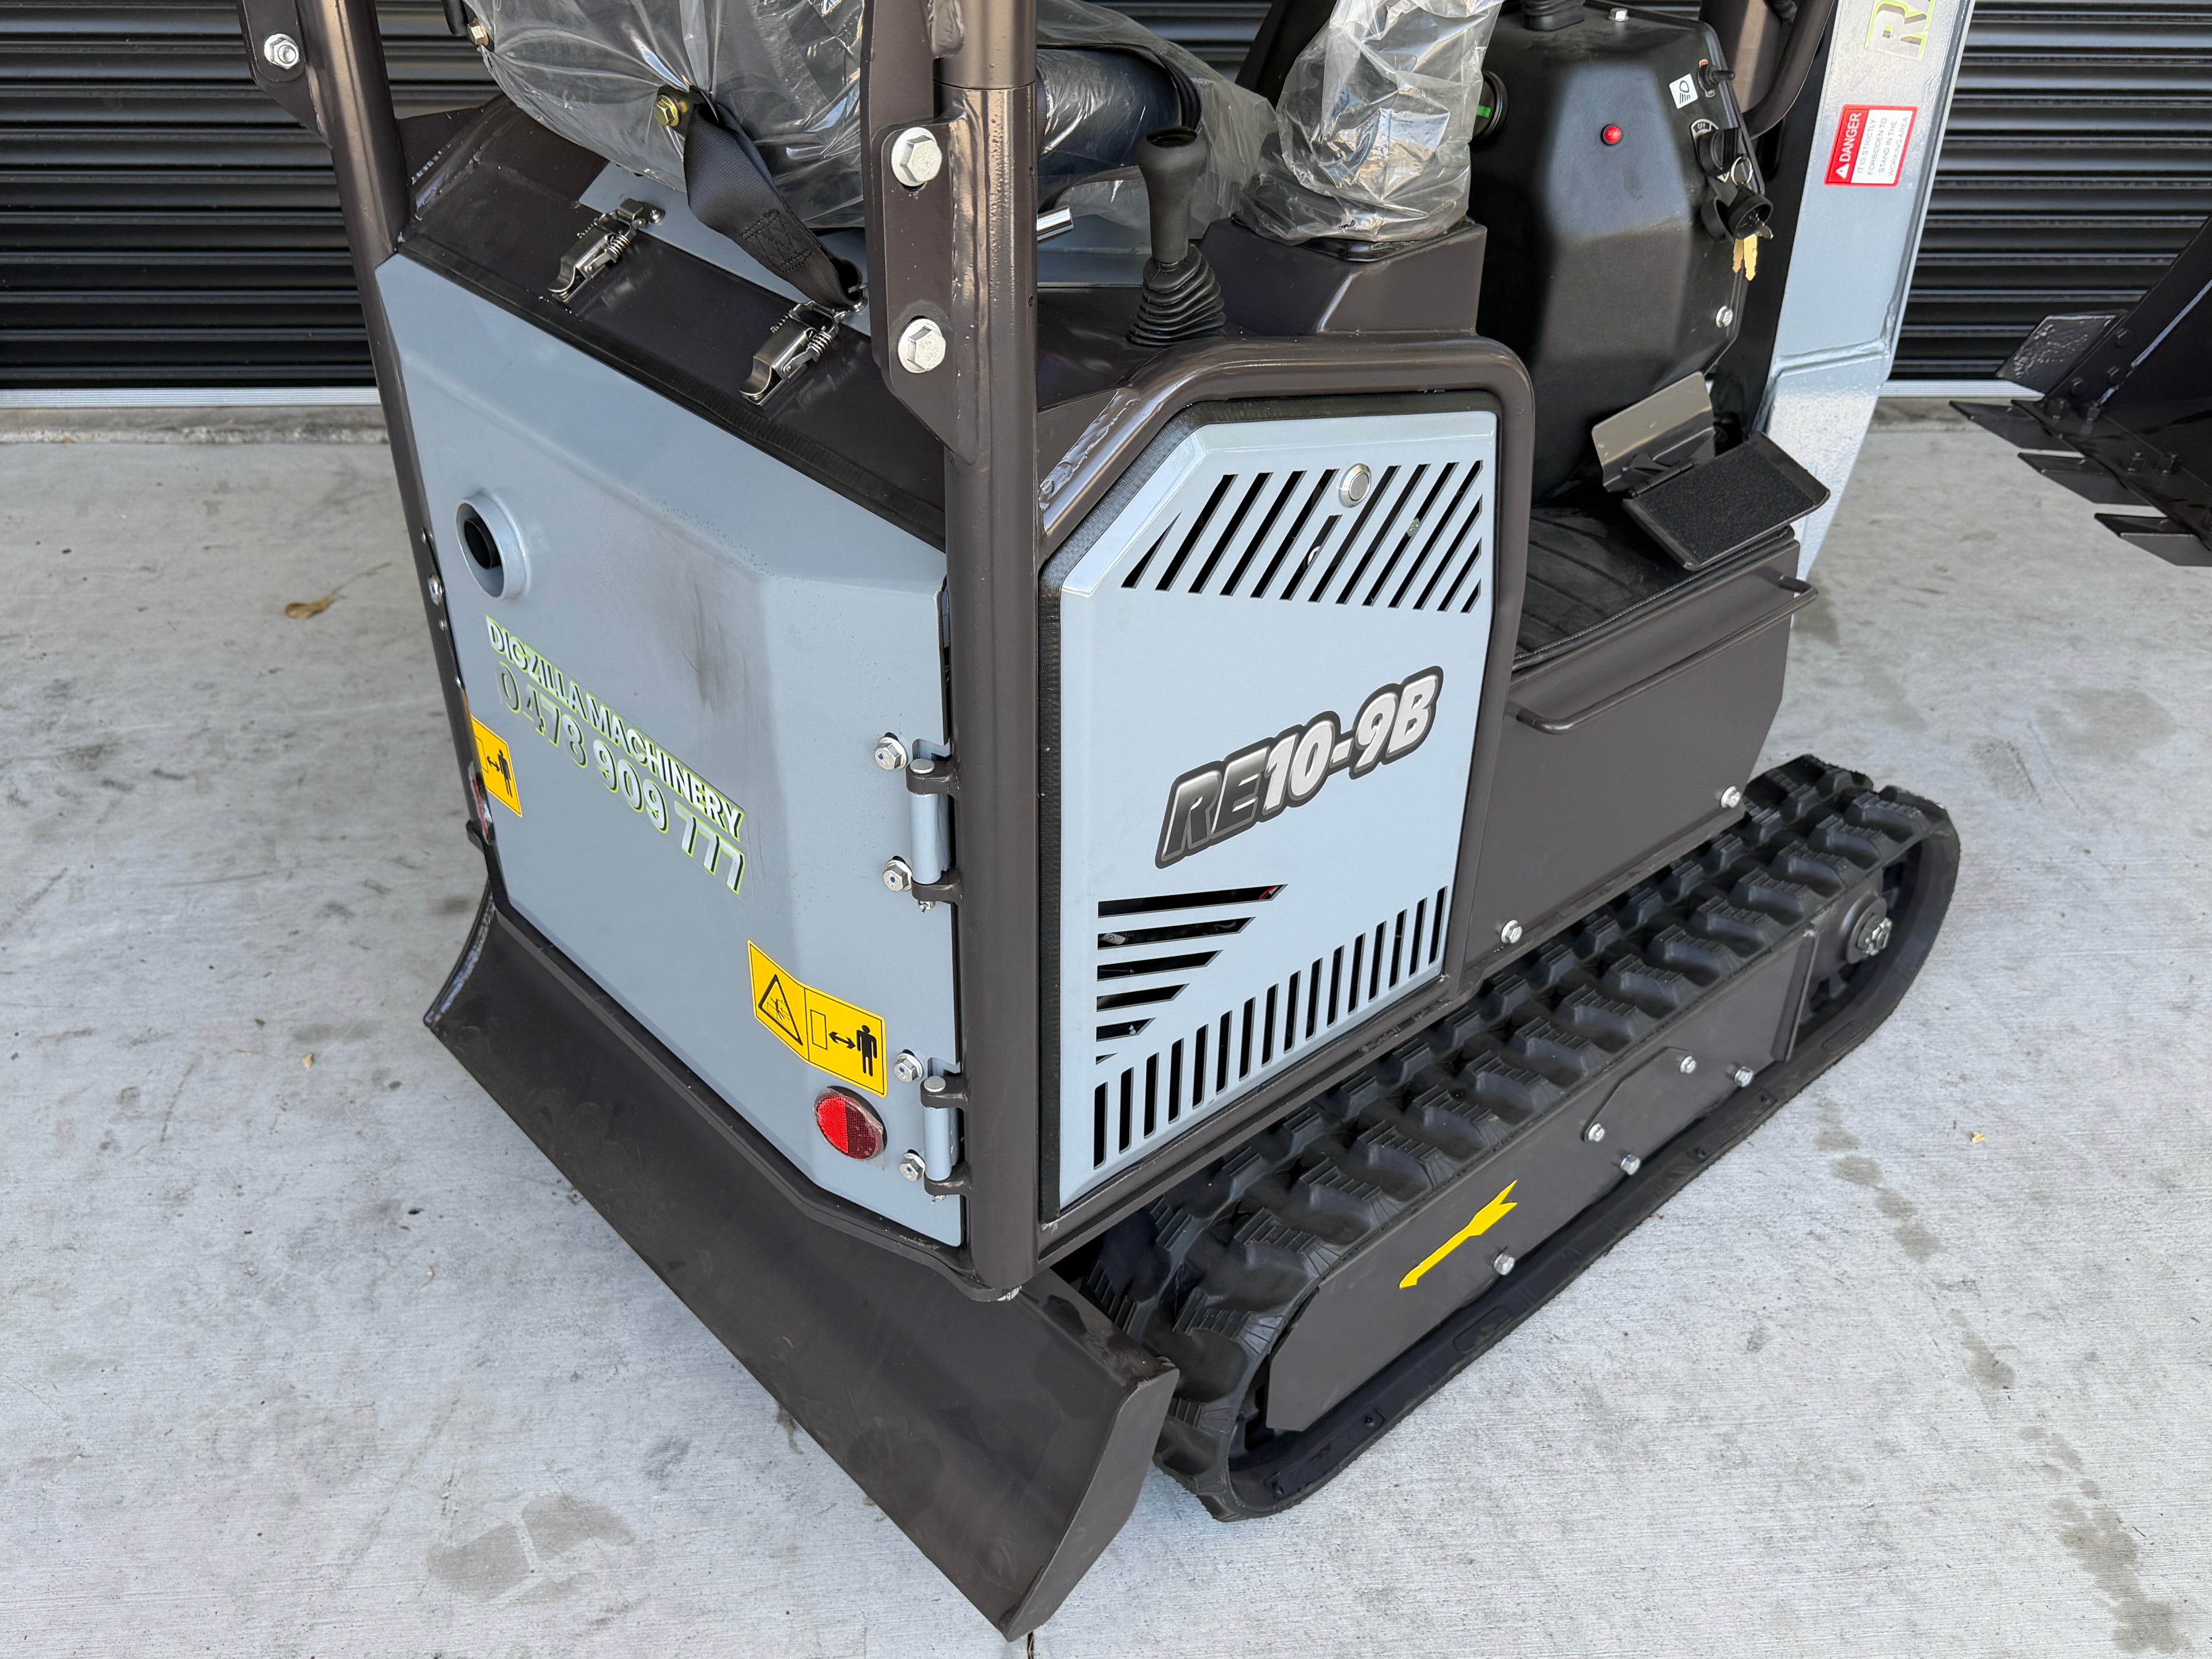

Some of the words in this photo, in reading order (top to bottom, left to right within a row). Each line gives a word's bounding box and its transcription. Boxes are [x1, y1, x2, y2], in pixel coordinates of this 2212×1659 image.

[1839, 112, 1862, 162] DANGER
[1862, 119, 1876, 156] STRICTLY
[1867, 130, 1884, 175] FORBIDDEN
[1879, 118, 1887, 128] TO
[1885, 138, 1892, 146] IN
[1888, 120, 1897, 136] THE
[1888, 139, 1902, 177] WORKING
[1898, 116, 1908, 138] AREA
[1878, 147, 1890, 173] STAND
[486, 615, 589, 723] DIGZILLA
[586, 692, 745, 842] MACHINERY
[1156, 666, 1444, 869] RE10-9B
[593, 740, 669, 834] 909
[674, 801, 745, 894] 777
